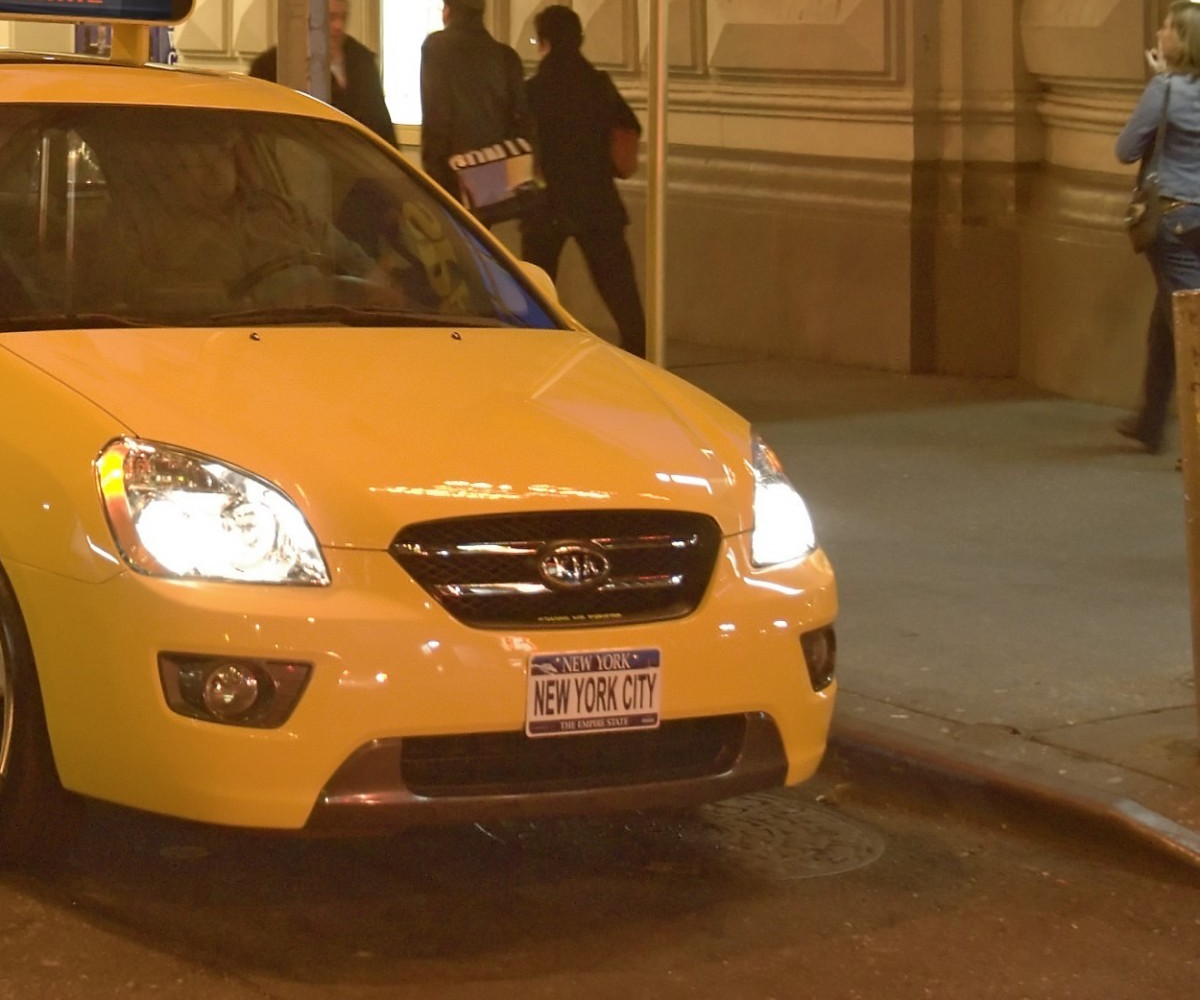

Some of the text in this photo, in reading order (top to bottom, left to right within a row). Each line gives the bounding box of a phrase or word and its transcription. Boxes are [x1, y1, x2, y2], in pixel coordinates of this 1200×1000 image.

[561, 653, 631, 673] NEW YORK
[534, 673, 657, 716] NEW YORK CITY
[560, 721, 576, 731] THE
[606, 717, 629, 727] STATE
